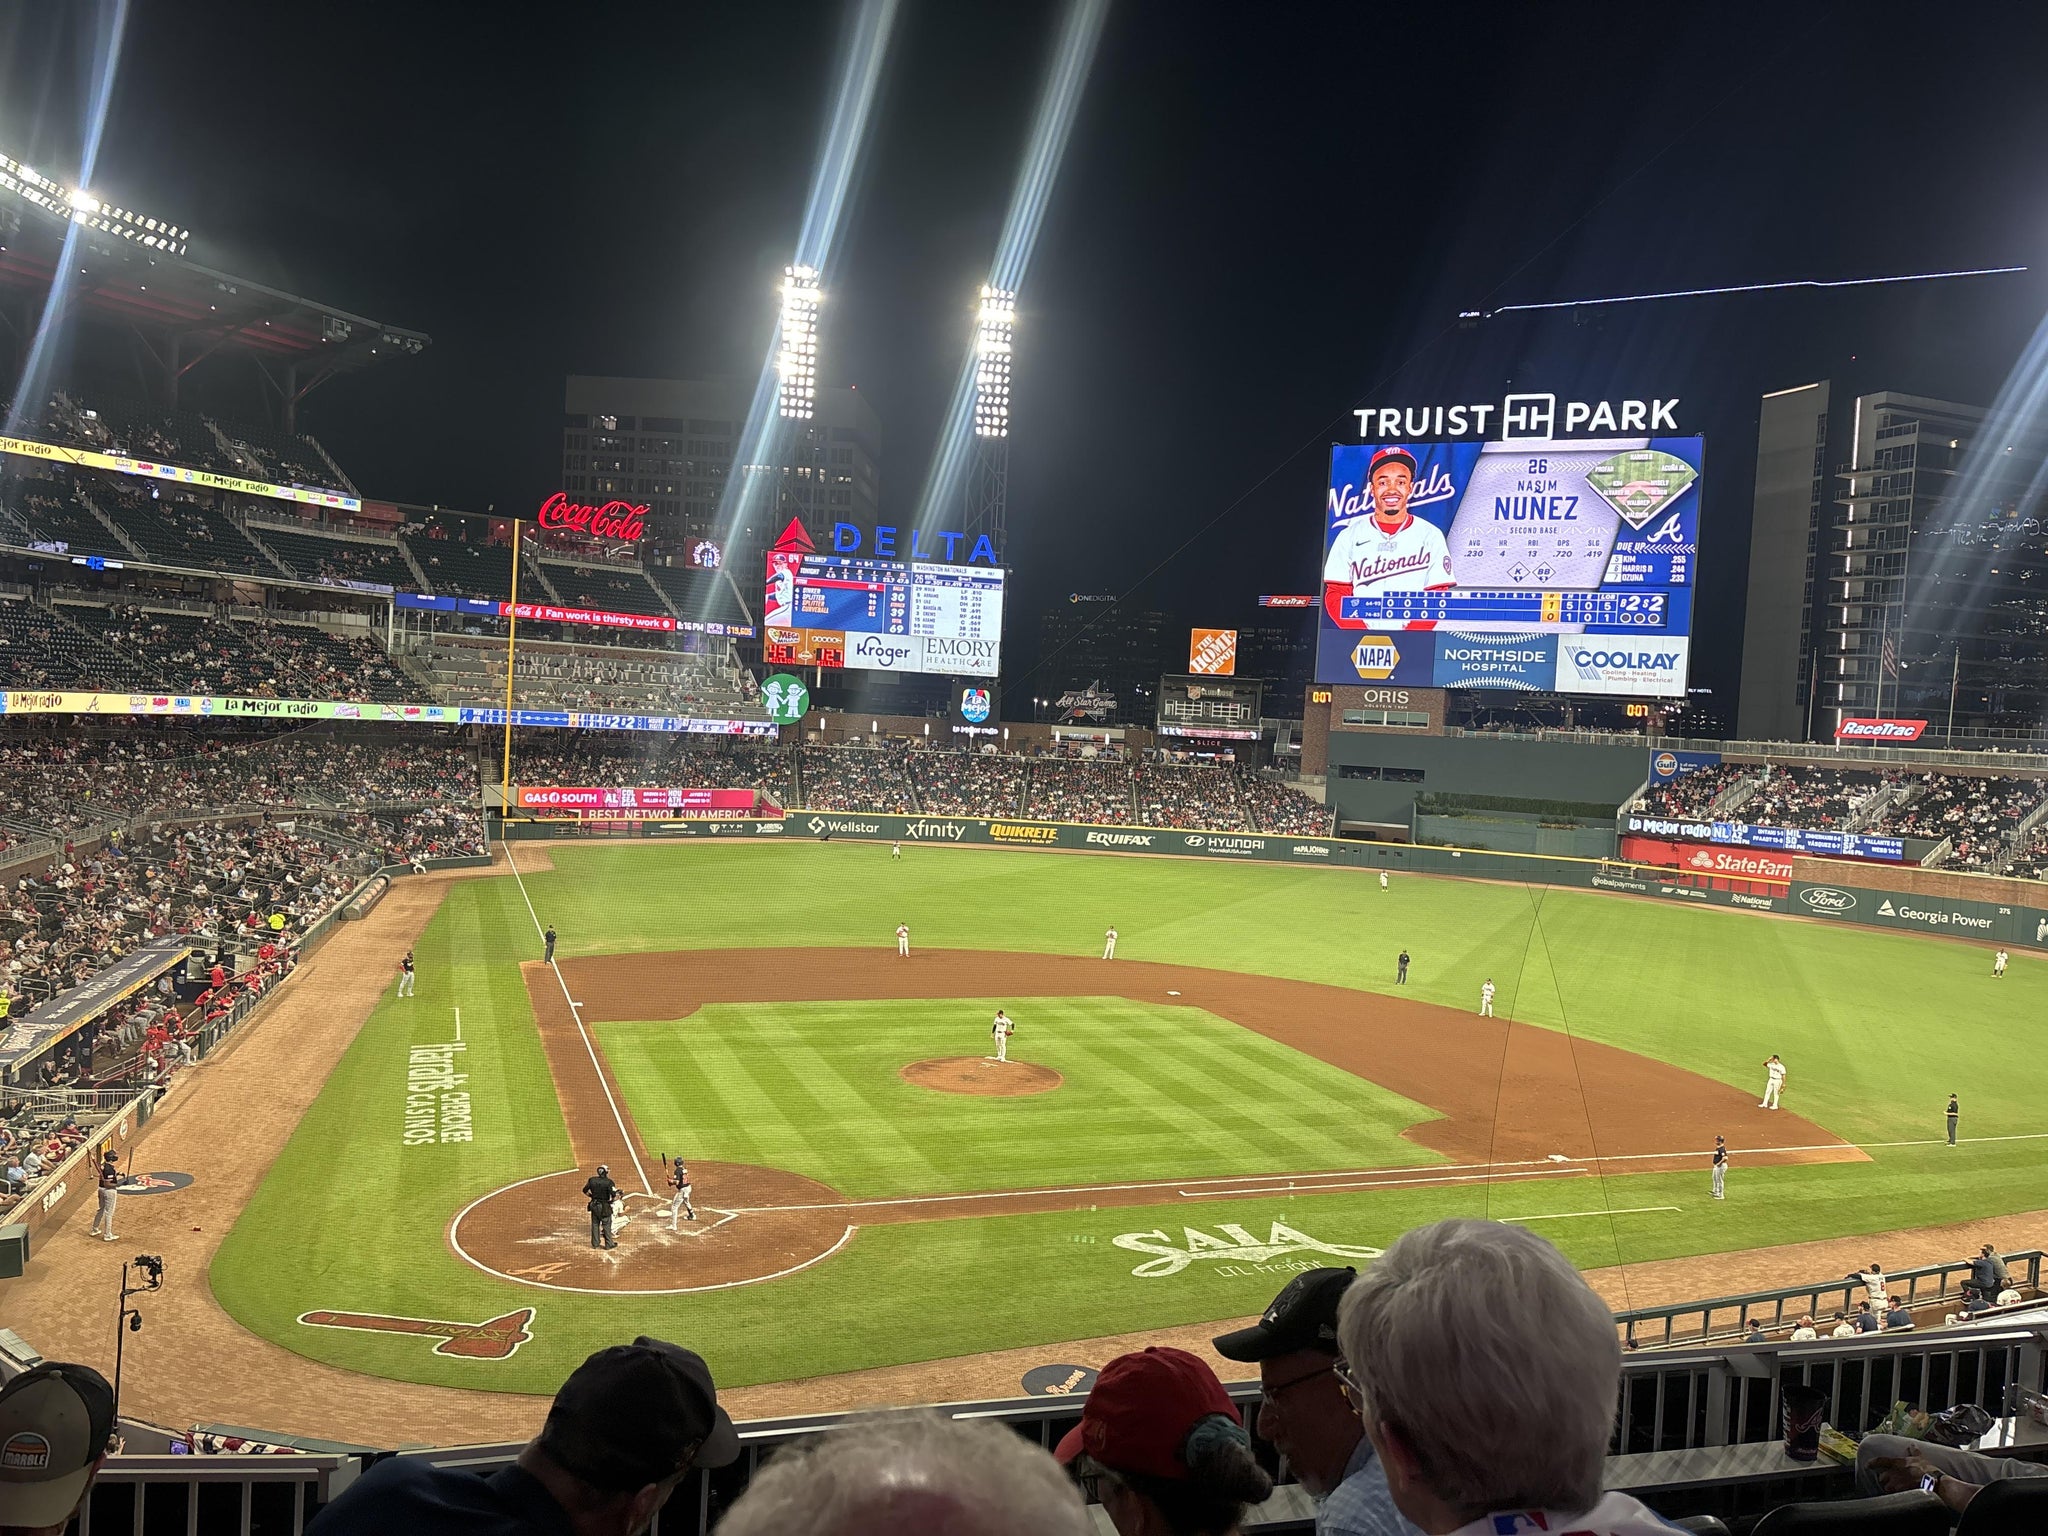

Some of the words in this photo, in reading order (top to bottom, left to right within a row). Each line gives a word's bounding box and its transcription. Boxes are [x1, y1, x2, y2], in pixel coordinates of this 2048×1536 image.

[1353, 404, 1495, 438] TRUIST
[1565, 398, 1680, 434] PARK
[23, 444, 51, 455] radio
[1528, 459, 1548, 474] 26
[201, 473, 211, 482] La
[214, 475, 242, 488] Mejor
[246, 481, 269, 492] radio
[1518, 480, 1557, 492] NASIM
[1510, 526, 1537, 534] SECOND
[1540, 526, 1558, 534] BASE
[834, 522, 997, 564] DELTA
[1616, 542, 1632, 551] DUE
[1635, 542, 1646, 551] UP
[1584, 550, 1602, 558] .419
[1671, 556, 1686, 564] .255
[1351, 546, 1431, 582] Nationals
[1622, 564, 1646, 572] HARRIS
[915, 574, 924, 584] 26
[1622, 574, 1644, 582] OZUNA
[891, 593, 905, 602] 30
[1270, 597, 1307, 606] RaceTrac
[1620, 599, 1626, 608] B
[1626, 596, 1640, 611] 2
[1642, 600, 1649, 608] S
[1649, 596, 1664, 611] 2
[1387, 599, 1394, 607] 0
[1404, 599, 1411, 607] 0
[1439, 600, 1446, 608] 0
[1566, 602, 1573, 610] 5
[1585, 602, 1592, 610] 0
[1604, 602, 1611, 610] 5
[546, 609, 563, 618] Fan
[566, 612, 590, 621] work
[593, 614, 600, 622] is
[602, 615, 634, 626] thirsty
[636, 618, 659, 628] work
[890, 609, 904, 617] 39
[1386, 610, 1393, 618] 0
[1403, 610, 1410, 618] 0
[1421, 610, 1428, 619] 0
[1438, 611, 1445, 619] 0
[1547, 612, 1554, 620] 0
[1567, 613, 1572, 621] 1
[1584, 613, 1591, 621] 0
[1604, 614, 1609, 622] 1
[677, 622, 691, 630] 8:16
[693, 623, 704, 632] PM
[890, 625, 904, 634] 69
[927, 638, 996, 657] EMORY
[1196, 634, 1215, 651] THE
[769, 645, 796, 659] 451
[822, 648, 843, 662] 127
[856, 636, 910, 667] Kroger
[1190, 631, 1236, 672] HOME
[1360, 648, 1392, 666] NAPA
[1445, 648, 1546, 662] NORTHSIDE
[926, 656, 992, 667] HEALTHCARE
[1207, 647, 1235, 672] DEPOT
[1575, 650, 1680, 670] COOLRAY
[561, 658, 630, 681] AARON
[626, 662, 713, 686] TERRACE
[1462, 663, 1526, 673] HOSPITAL
[1201, 689, 1234, 698] CLUBHOUSE
[1313, 692, 1331, 703] 0:07
[1364, 690, 1409, 704] ORIS
[12, 694, 20, 707] La
[20, 694, 38, 710] Mejor
[40, 694, 62, 708] radio
[225, 700, 238, 710] La
[242, 701, 281, 715] Mejor
[287, 703, 318, 715] radio
[1056, 694, 1074, 707] All
[1074, 697, 1092, 706] Star
[1093, 698, 1117, 709] Game
[1627, 705, 1648, 716] 0:07
[611, 716, 618, 727] 2
[626, 717, 635, 728] 2
[1842, 722, 1915, 736] RaceTrac
[525, 793, 547, 803] GAS
[562, 794, 597, 803] SOUTH
[605, 793, 618, 803] AL
[588, 810, 619, 819] BEST
[686, 810, 696, 819] IN
[700, 810, 750, 819] AMERICA
[827, 821, 880, 833] Wellstar
[906, 820, 965, 840] xfinity
[990, 824, 1058, 839] QUIKRETE
[1629, 818, 1641, 831] La
[1643, 819, 1679, 834] Mejor
[1681, 824, 1711, 838] radio
[1713, 827, 1729, 838] NL
[1733, 825, 1748, 833] LAD
[1086, 832, 1152, 846] EQUIFAX
[1786, 830, 1801, 838] MIL
[1844, 835, 1860, 843] STL
[1209, 838, 1264, 850] HYUNDAI
[1740, 897, 1772, 906] National
[1809, 890, 1847, 908] Ford
[1899, 906, 1948, 925] Georgia
[1952, 910, 1992, 929] Power
[403, 1094, 436, 1145] CASINOS
[440, 1092, 473, 1143] CHEROKEE
[1112, 1221, 1355, 1277] SAIA
[1214, 1266, 1254, 1277] LTL
[1253, 1259, 1324, 1274] Freight
[4, 1452, 46, 1465] MARBLE
